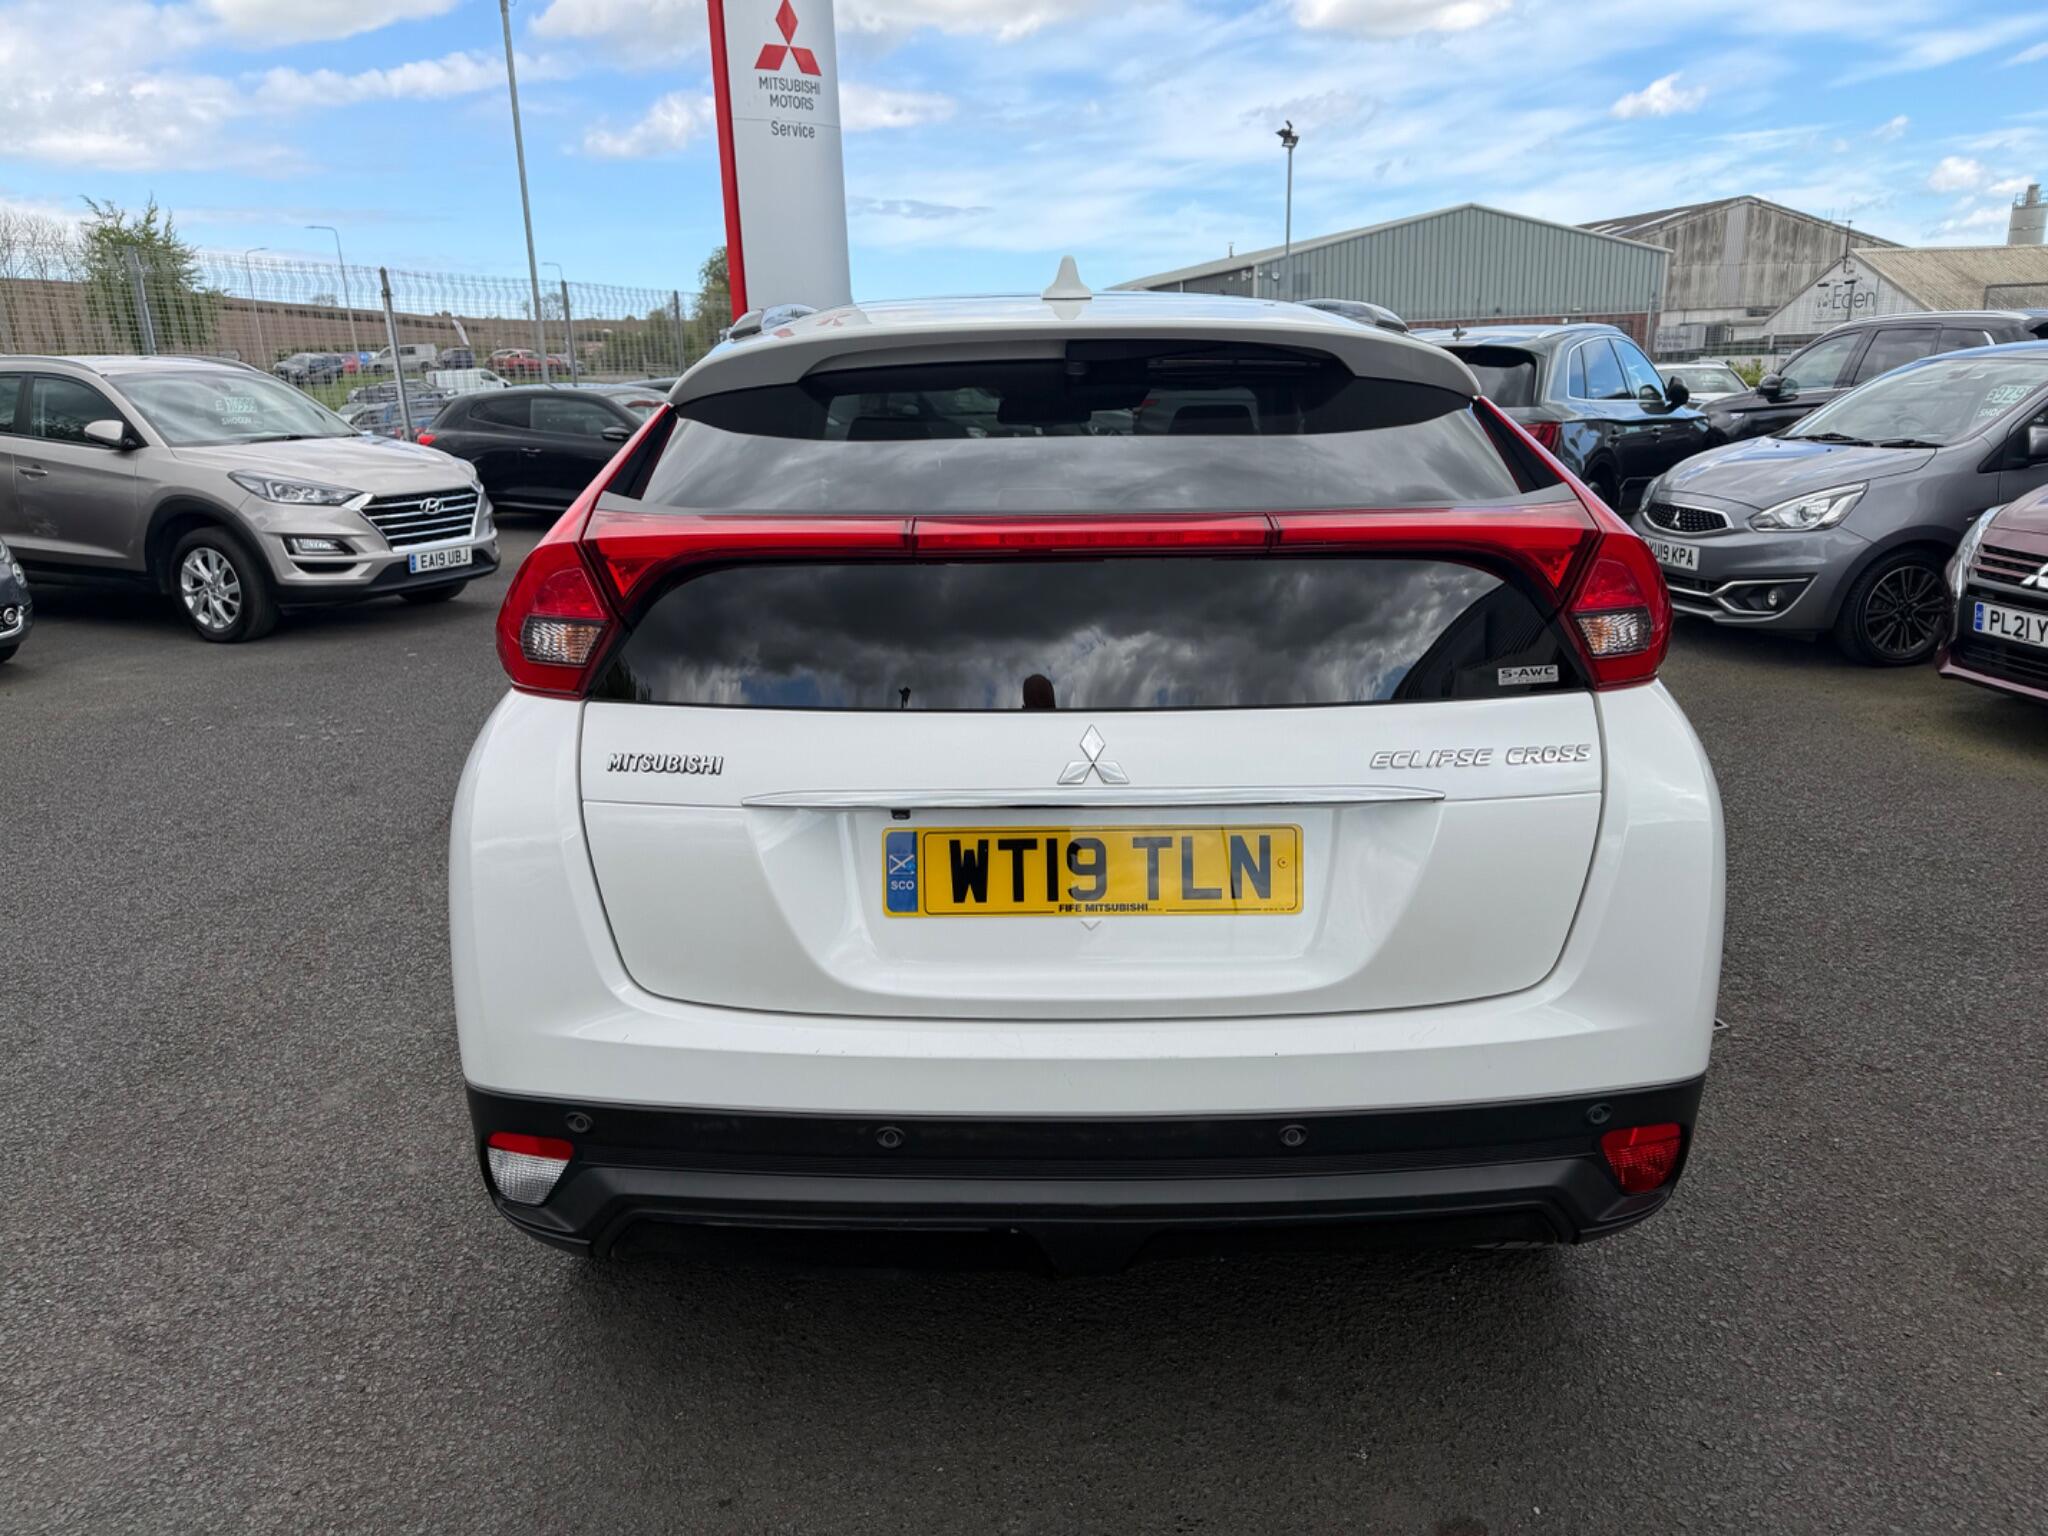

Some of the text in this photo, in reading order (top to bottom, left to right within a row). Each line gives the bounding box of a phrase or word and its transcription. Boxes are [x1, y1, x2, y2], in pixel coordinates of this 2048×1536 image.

[758, 76, 821, 95] MITSUBISHI
[769, 94, 814, 111] MOTORS
[771, 120, 815, 138] Service
[1831, 284, 1875, 309] Eden
[420, 548, 469, 569] EA19 UBJ
[1671, 545, 1694, 567] KPA
[1988, 609, 2031, 640] PL21
[1501, 666, 1554, 679] S-AWC
[607, 753, 724, 775] MITSUBISHI
[1369, 743, 1592, 769] ECLIPSE CROSS
[949, 834, 1272, 904] WT19 TLN
[890, 880, 915, 890] SCO
[1059, 904, 1082, 913] FIFE
[1085, 903, 1149, 913] MITSUBISHI
